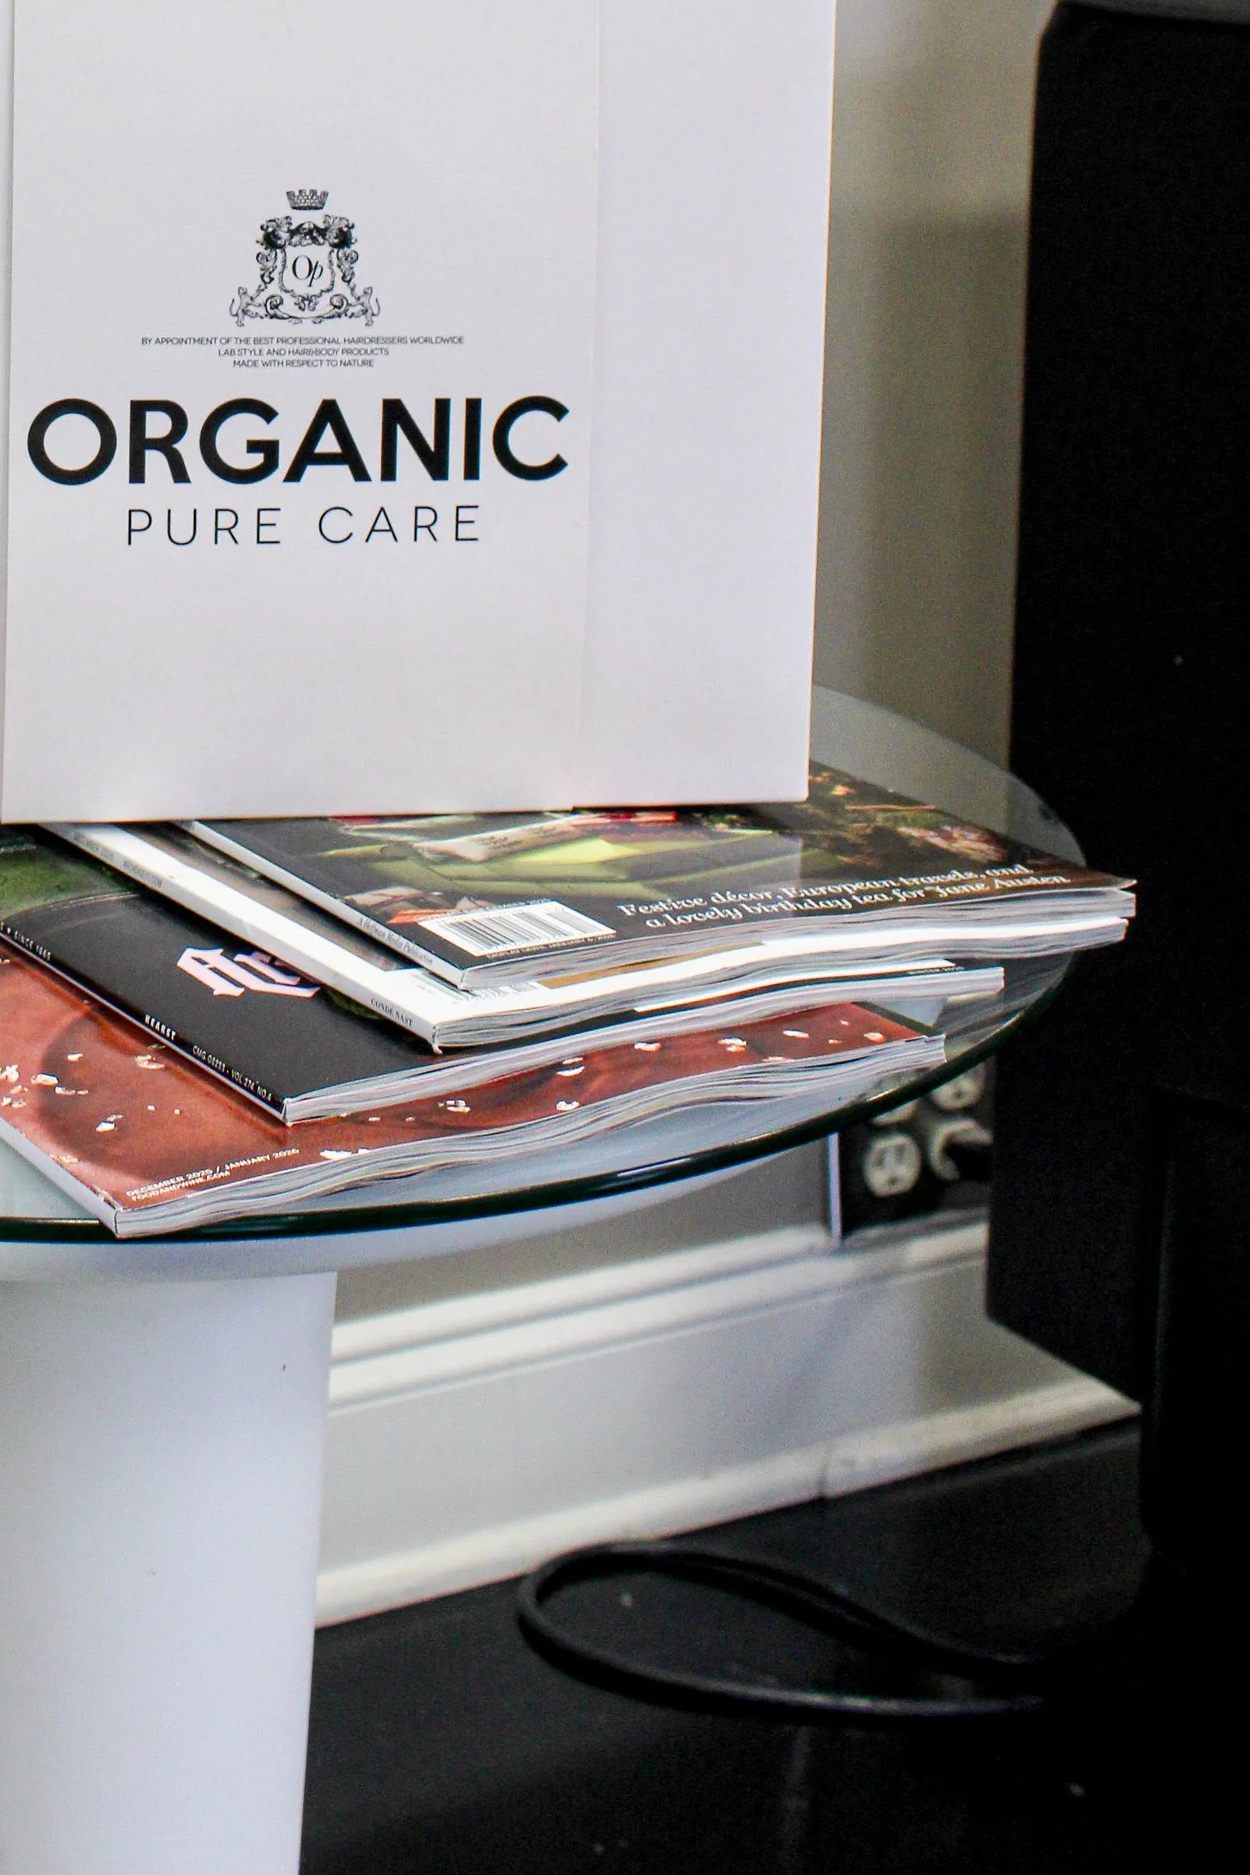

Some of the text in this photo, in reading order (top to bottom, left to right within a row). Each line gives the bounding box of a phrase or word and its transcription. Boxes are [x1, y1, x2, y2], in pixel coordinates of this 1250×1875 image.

[141, 336, 465, 345] BY APPOINTMENT OF THE BEST PROFESSIONAL HAIRDRESSERS WORLDWIDE
[218, 348, 236, 357] LAB
[237, 348, 264, 357] STYLE
[266, 348, 287, 356] AND
[341, 347, 390, 356] PRODUCTS
[232, 359, 374, 368] MADE WITH RESPECT TO NATURE
[27, 395, 570, 486] ORGANIC
[127, 504, 480, 546] PURE CARE
[617, 894, 708, 917] Festive
[781, 877, 899, 898] European
[986, 863, 1034, 877] and
[645, 874, 1071, 929] a lovely birthday tea for Jane Austen
[144, 1013, 176, 1041] HEARST
[126, 1174, 186, 1197] DECEMBER
[224, 1153, 271, 1171] JANUARY
